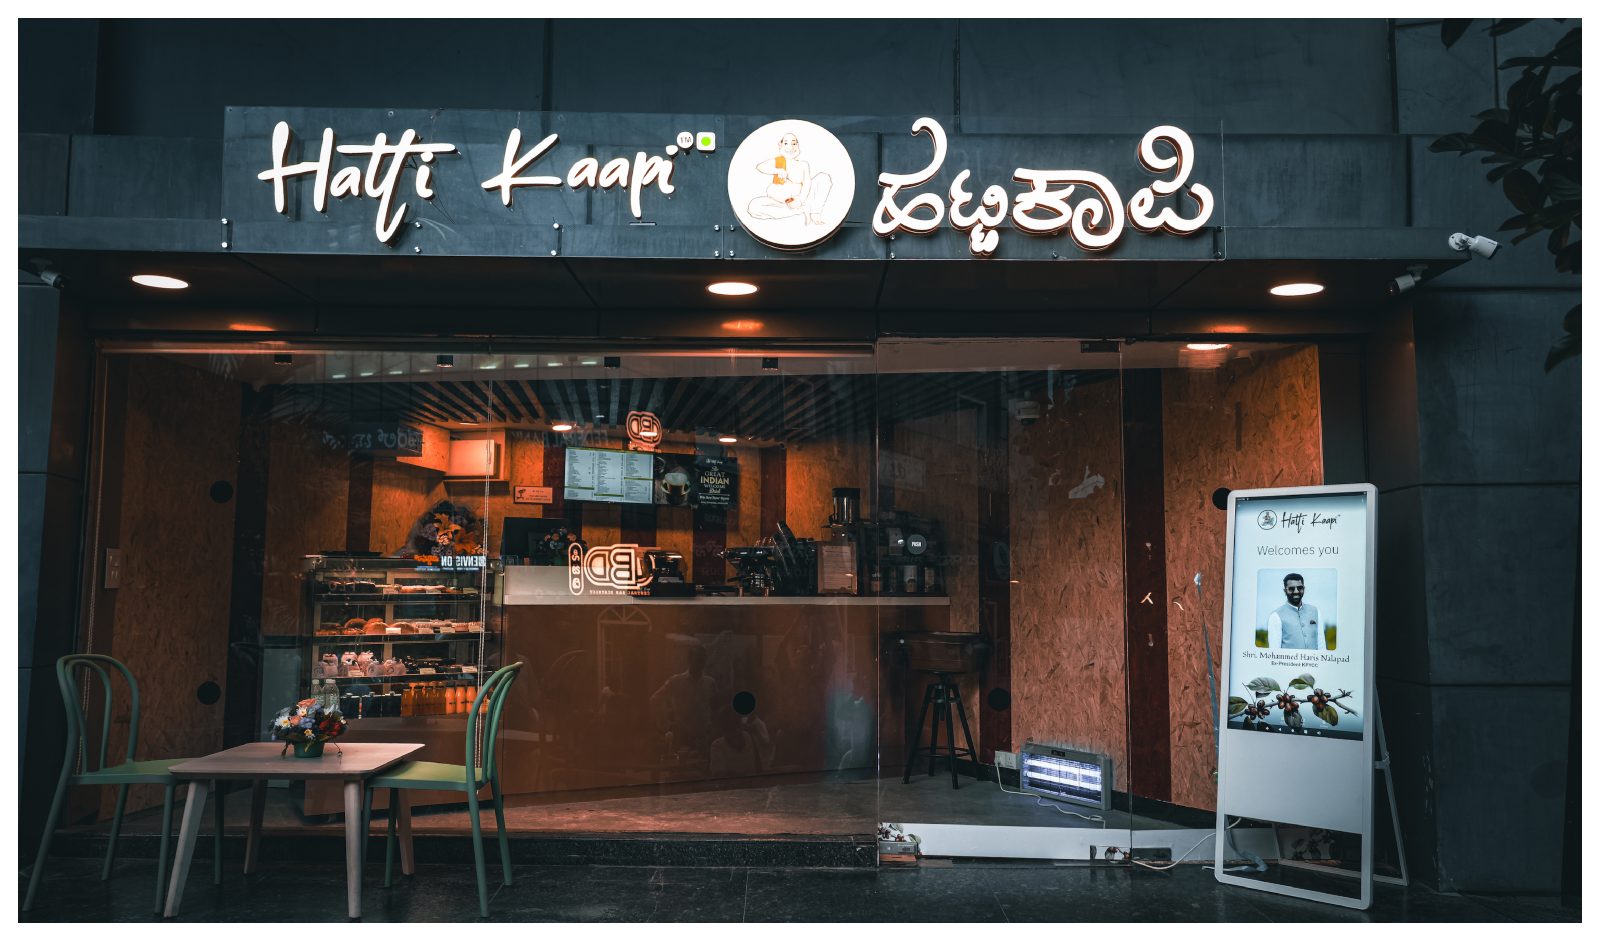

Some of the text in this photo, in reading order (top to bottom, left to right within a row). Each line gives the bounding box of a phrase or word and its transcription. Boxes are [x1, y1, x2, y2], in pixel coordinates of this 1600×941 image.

[258, 121, 456, 243] Hatti
[481, 128, 677, 218] Kaapi
[700, 475, 730, 485] INDIAN
[1281, 512, 1337, 533] Hatti Kaapi
[1257, 545, 1339, 557] Welcomes you
[1259, 651, 1298, 661] Mohammed
[1300, 653, 1319, 661] Haris
[1320, 654, 1350, 665] Nalapad
